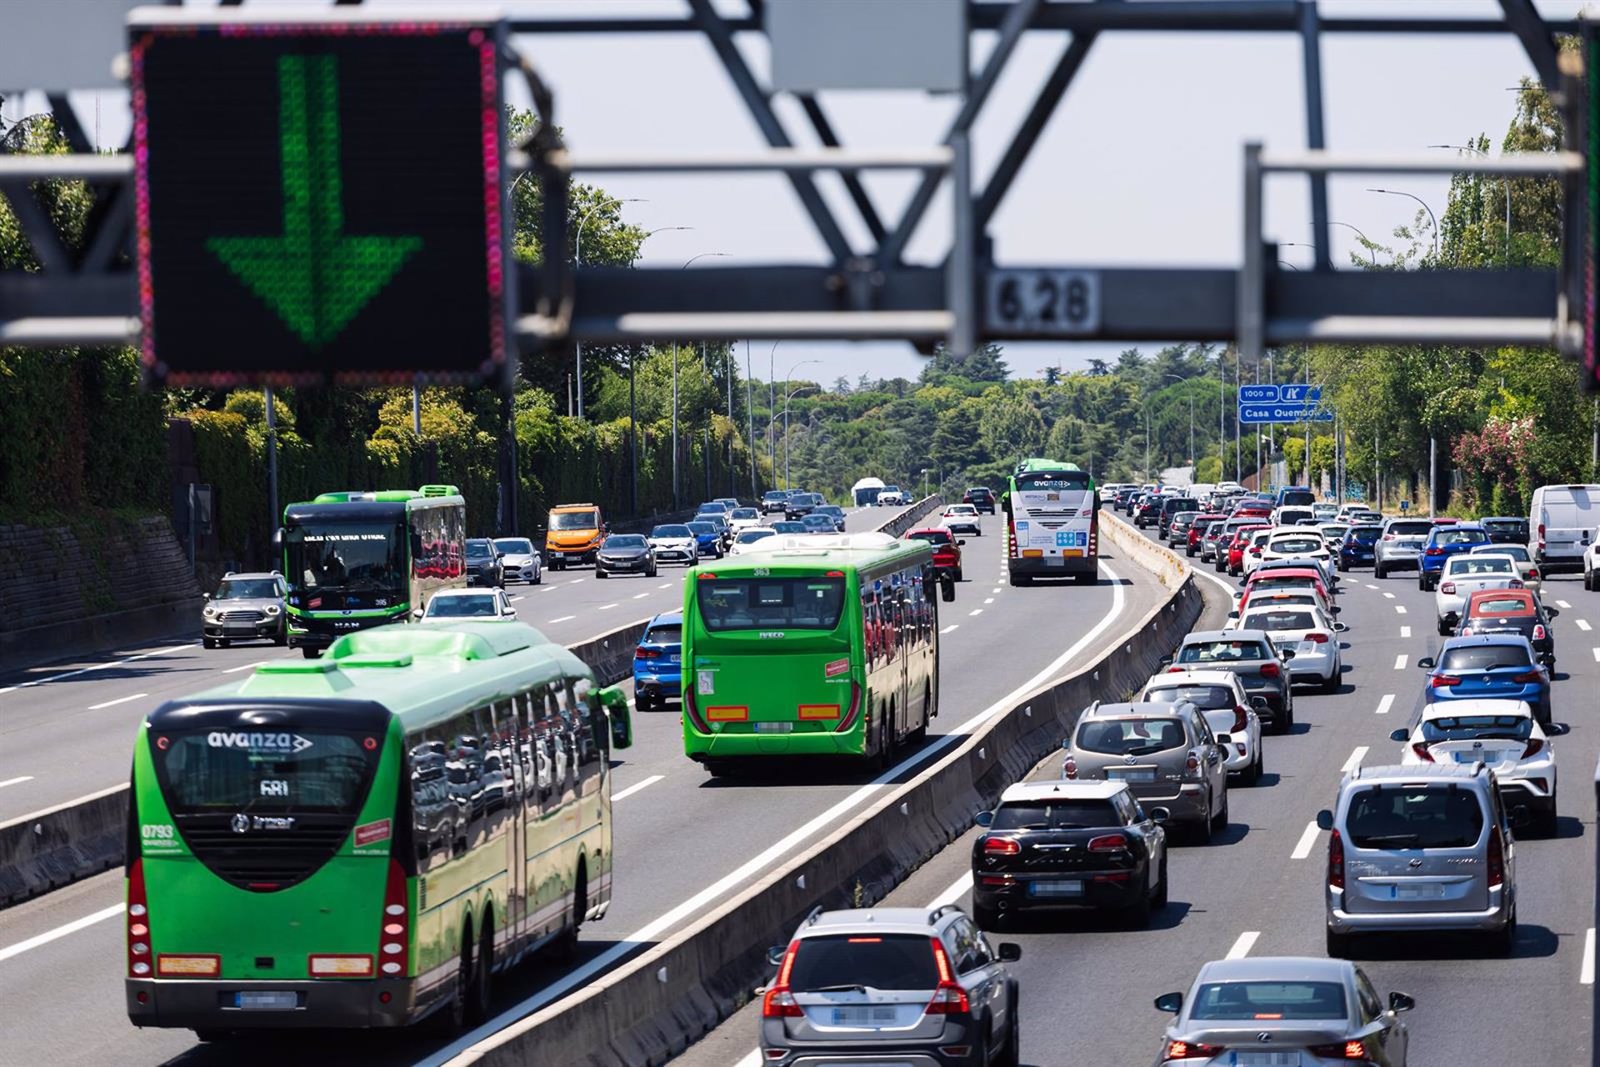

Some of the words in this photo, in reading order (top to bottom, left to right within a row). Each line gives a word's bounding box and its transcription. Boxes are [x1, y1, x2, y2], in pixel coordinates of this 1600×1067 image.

[1245, 409, 1269, 417] Casa
[753, 568, 770, 577] 363
[207, 731, 291, 748] avanza
[142, 824, 174, 839] 0793
